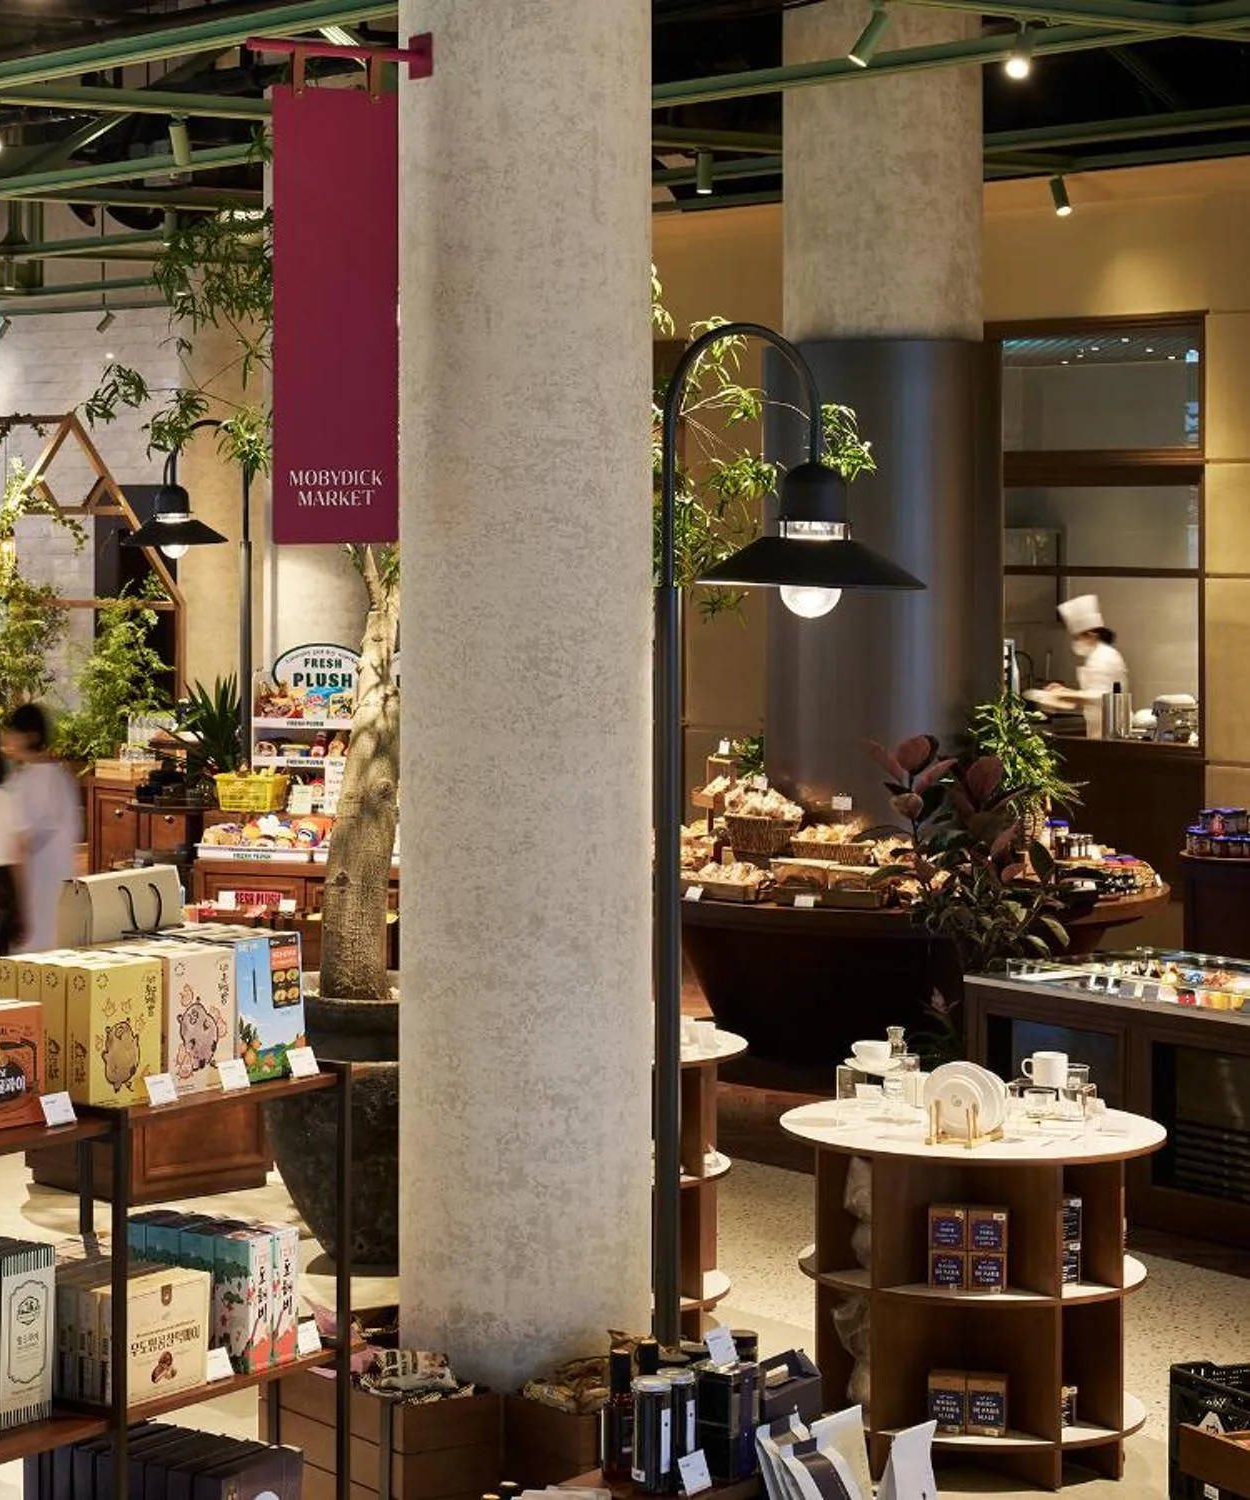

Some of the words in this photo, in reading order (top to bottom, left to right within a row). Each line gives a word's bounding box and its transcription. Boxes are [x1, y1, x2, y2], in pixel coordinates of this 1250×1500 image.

[289, 469, 383, 486] MOBYDICK
[298, 490, 375, 506] MARKET
[304, 658, 343, 669] FRESH
[293, 673, 352, 688] PLUSH
